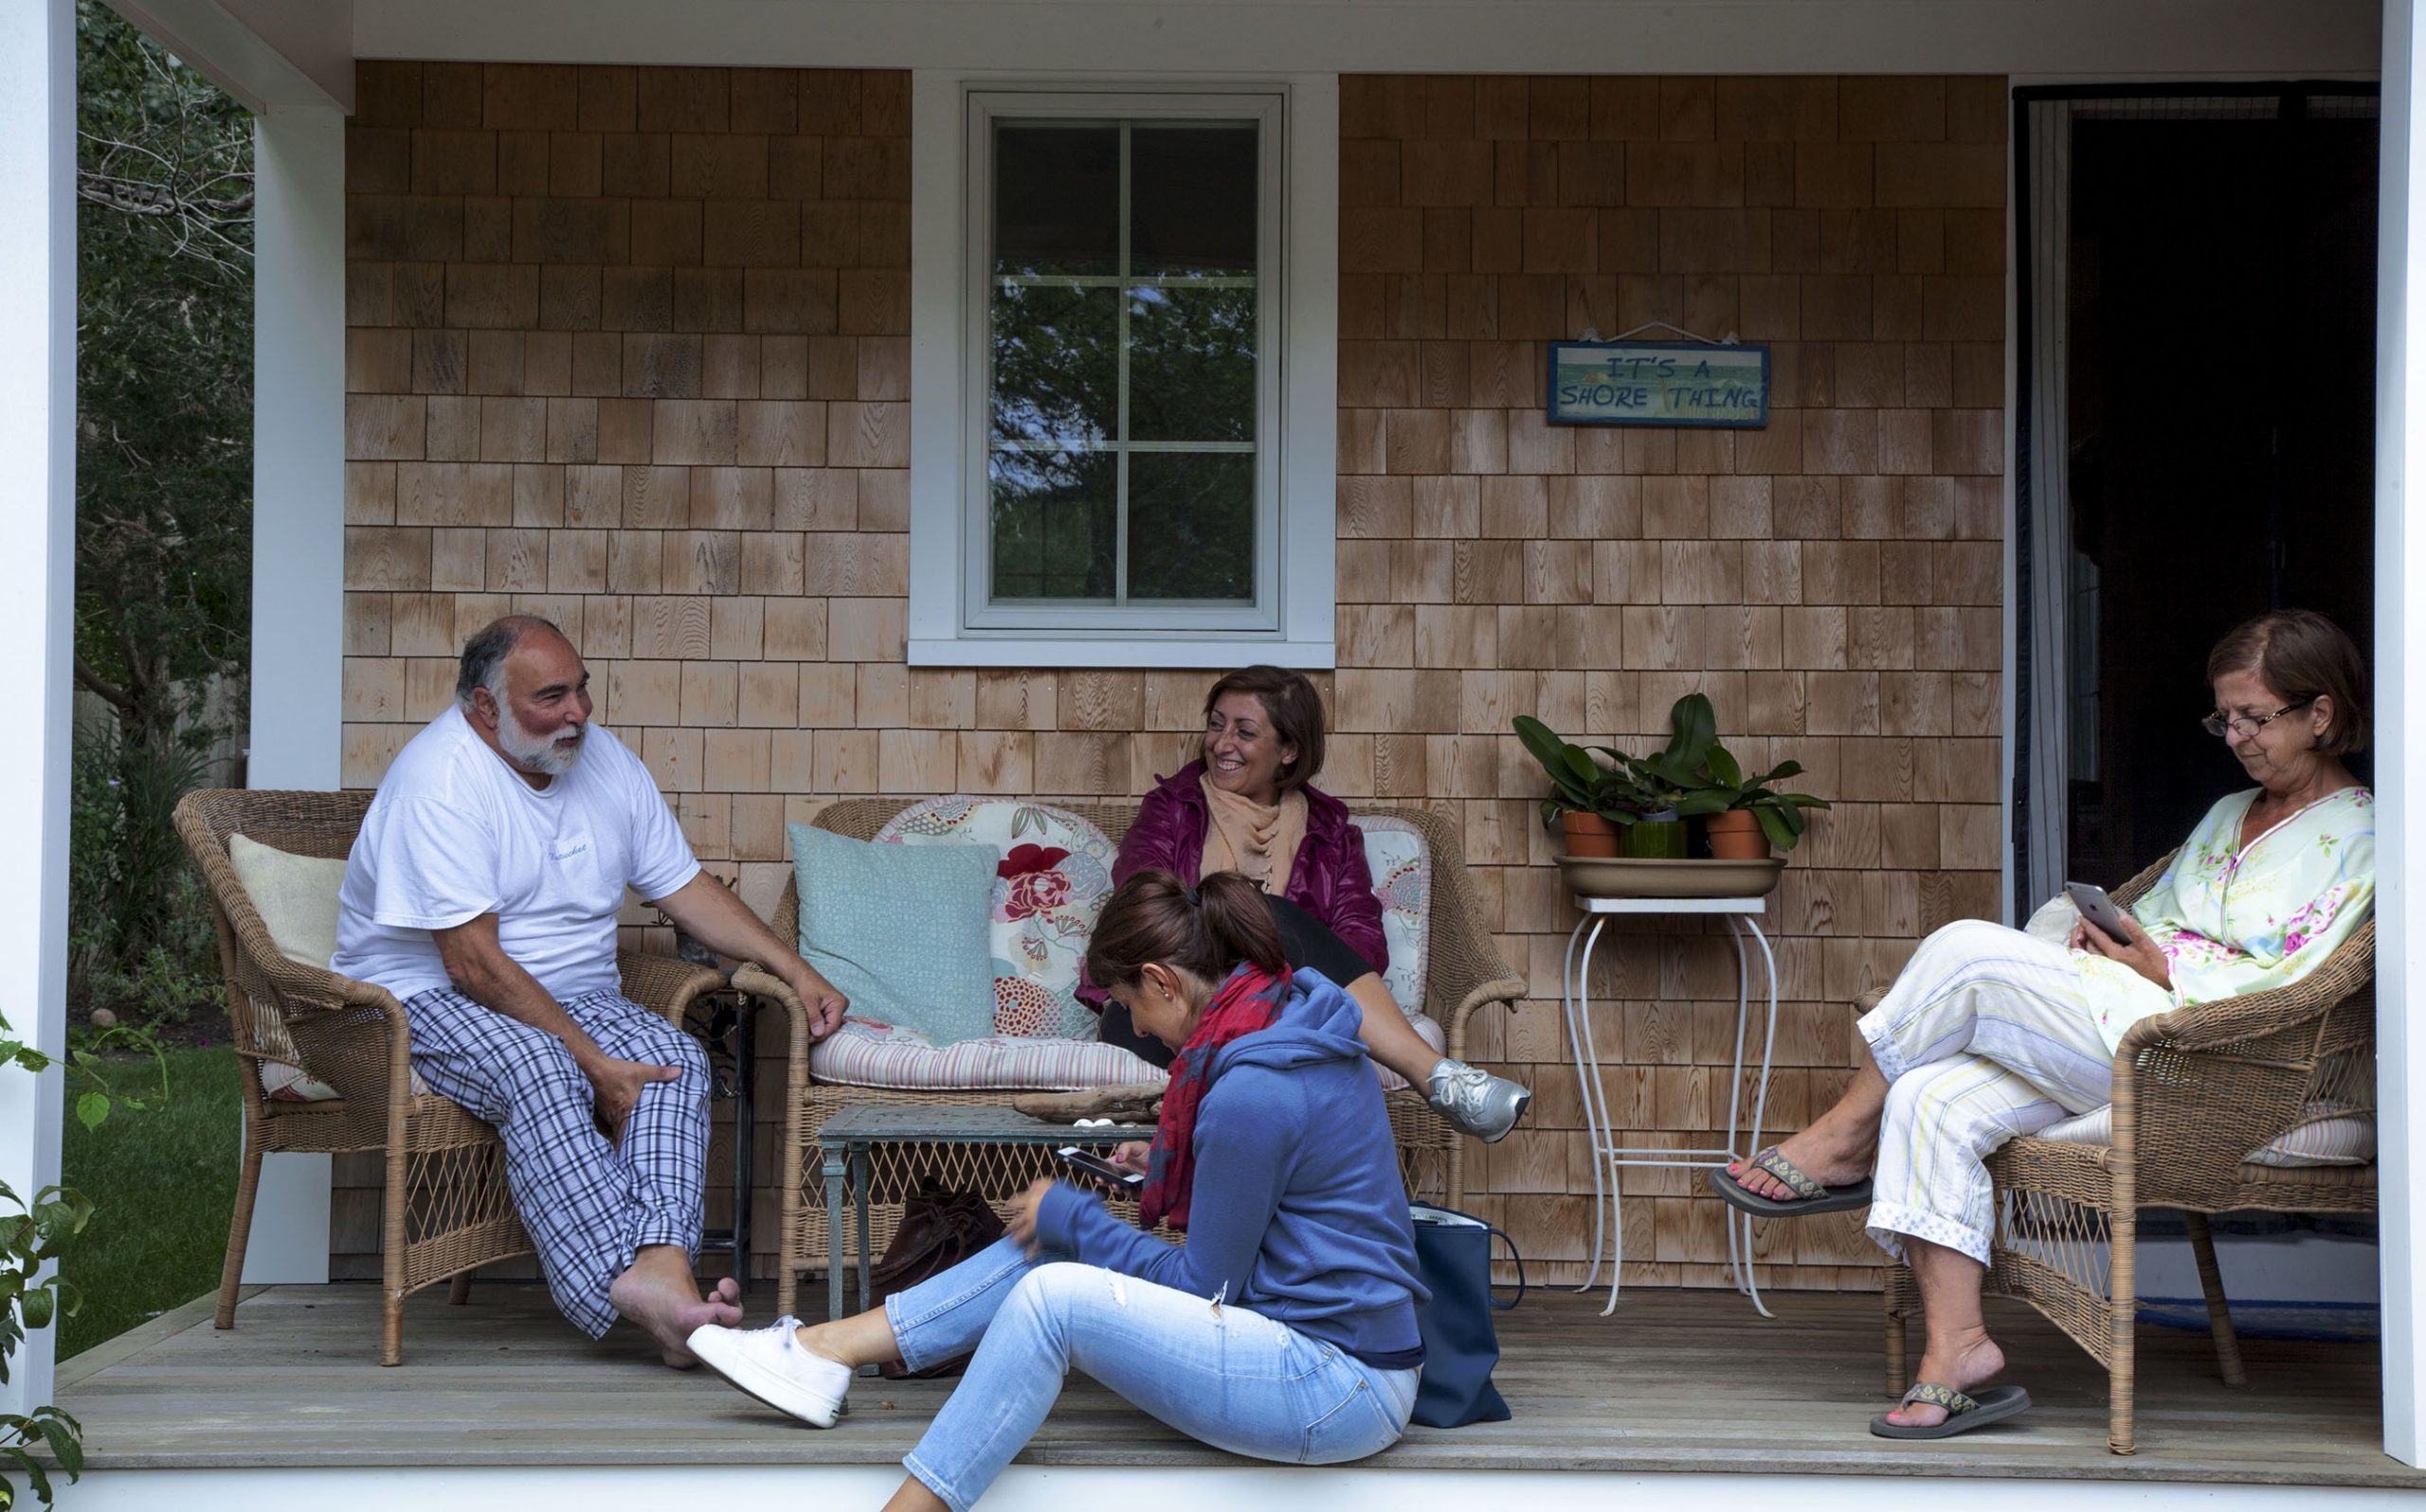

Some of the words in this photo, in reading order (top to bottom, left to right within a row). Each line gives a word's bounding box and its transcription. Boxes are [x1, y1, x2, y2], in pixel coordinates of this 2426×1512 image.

[1606, 355, 1675, 379] IT'S
[1693, 360, 1711, 379] A
[1560, 385, 1648, 408] SHORE
[1668, 387, 1760, 408] THING
